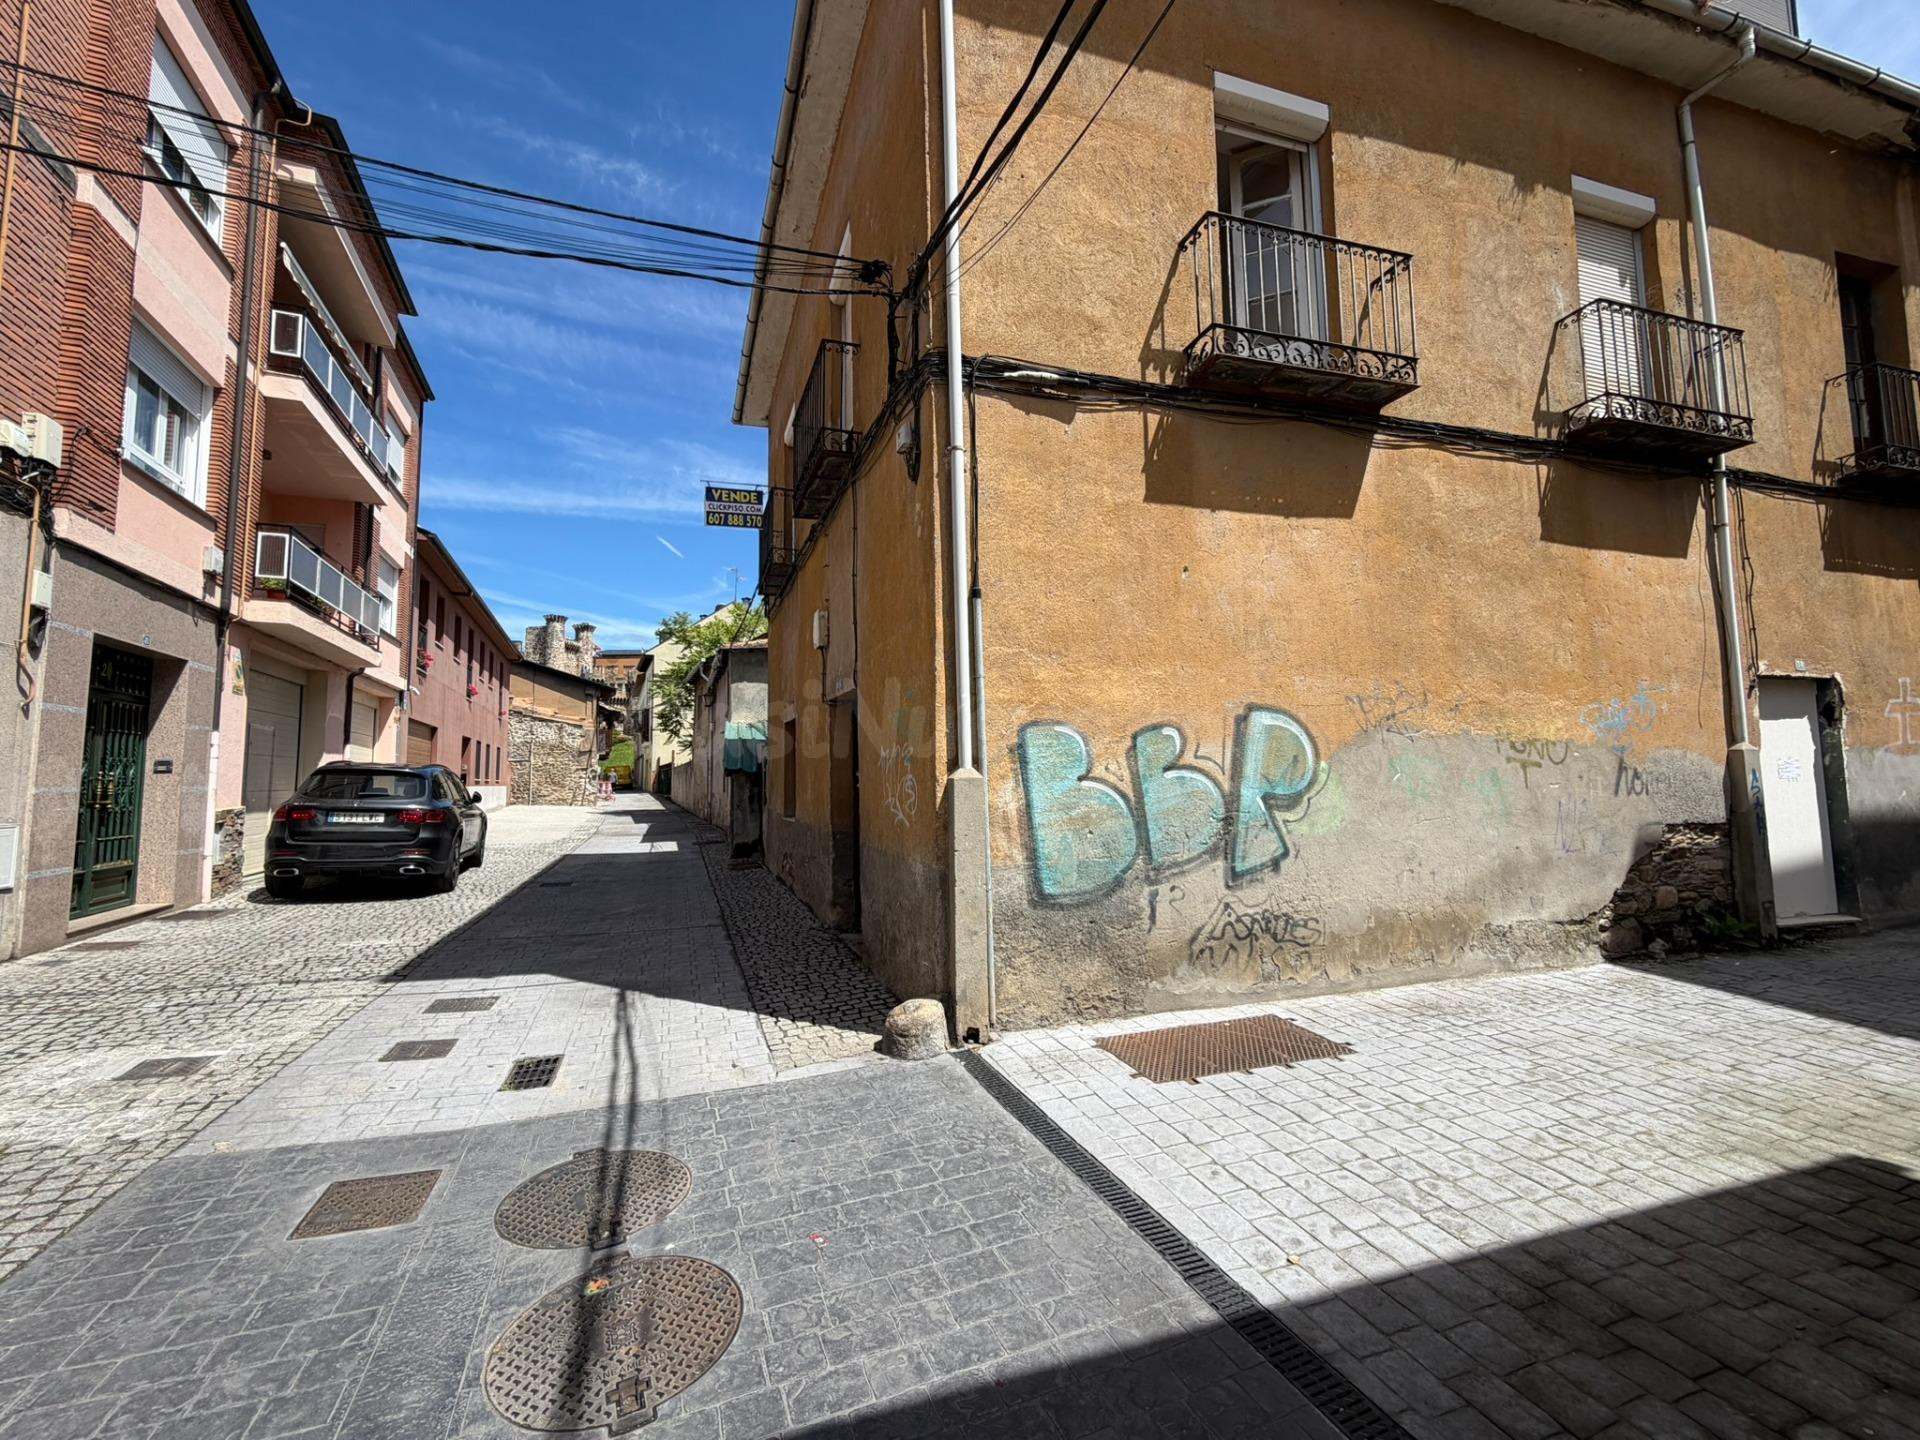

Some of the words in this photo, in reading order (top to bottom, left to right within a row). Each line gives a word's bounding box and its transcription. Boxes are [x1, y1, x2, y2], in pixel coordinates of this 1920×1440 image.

[712, 489, 758, 503] VENDE
[708, 503, 762, 512] CLICKPISO.COM
[708, 512, 726, 525] 607
[728, 514, 743, 525] 888
[746, 516, 762, 527] 570
